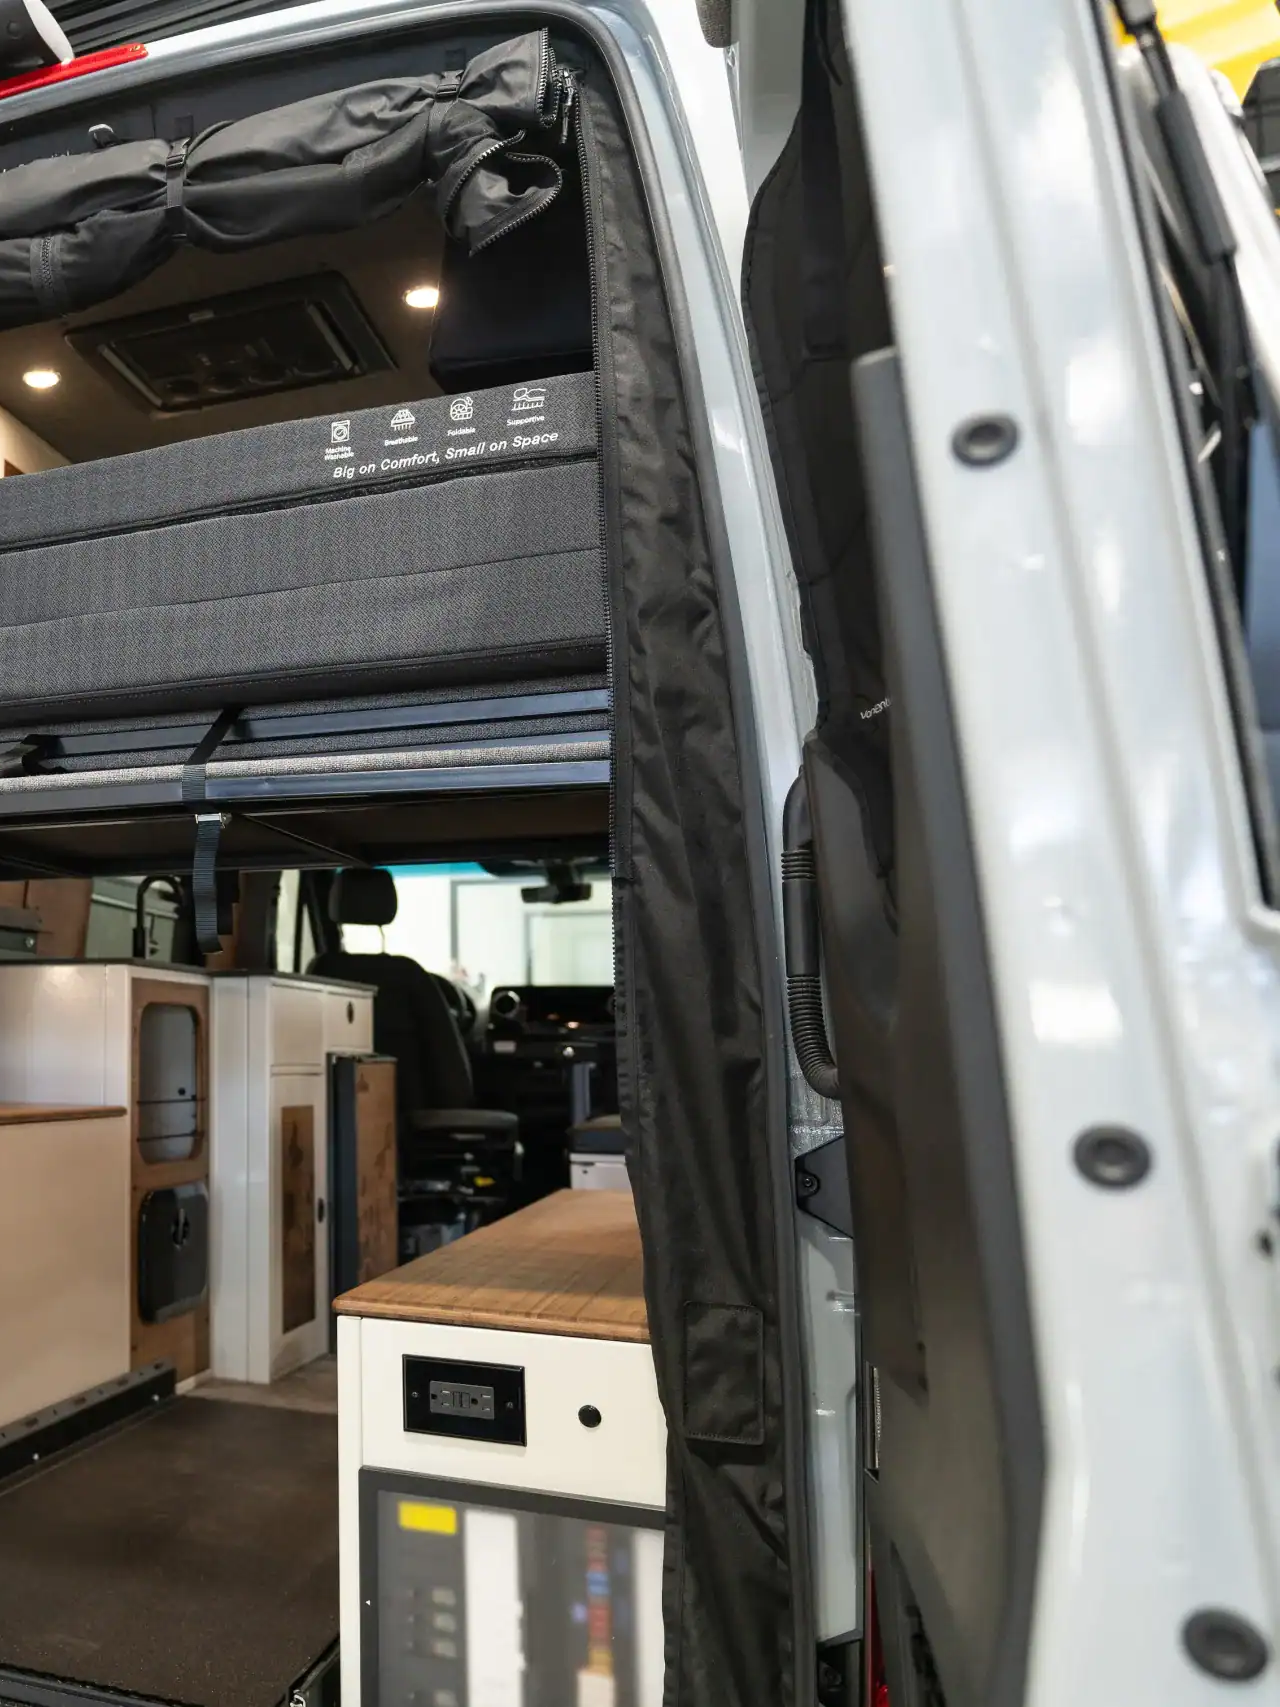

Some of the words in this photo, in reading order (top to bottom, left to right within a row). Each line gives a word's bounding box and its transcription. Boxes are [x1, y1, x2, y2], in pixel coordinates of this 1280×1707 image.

[506, 414, 545, 426] Supportive
[447, 427, 476, 437] Foldable
[384, 435, 418, 446] Breathable
[325, 446, 352, 454] Machine
[324, 452, 355, 460] Washable
[333, 465, 355, 479] Big
[359, 463, 376, 474] on
[380, 451, 440, 471] Comfort,
[444, 441, 486, 459] Small
[489, 440, 507, 452] on
[512, 432, 559, 449] Space
